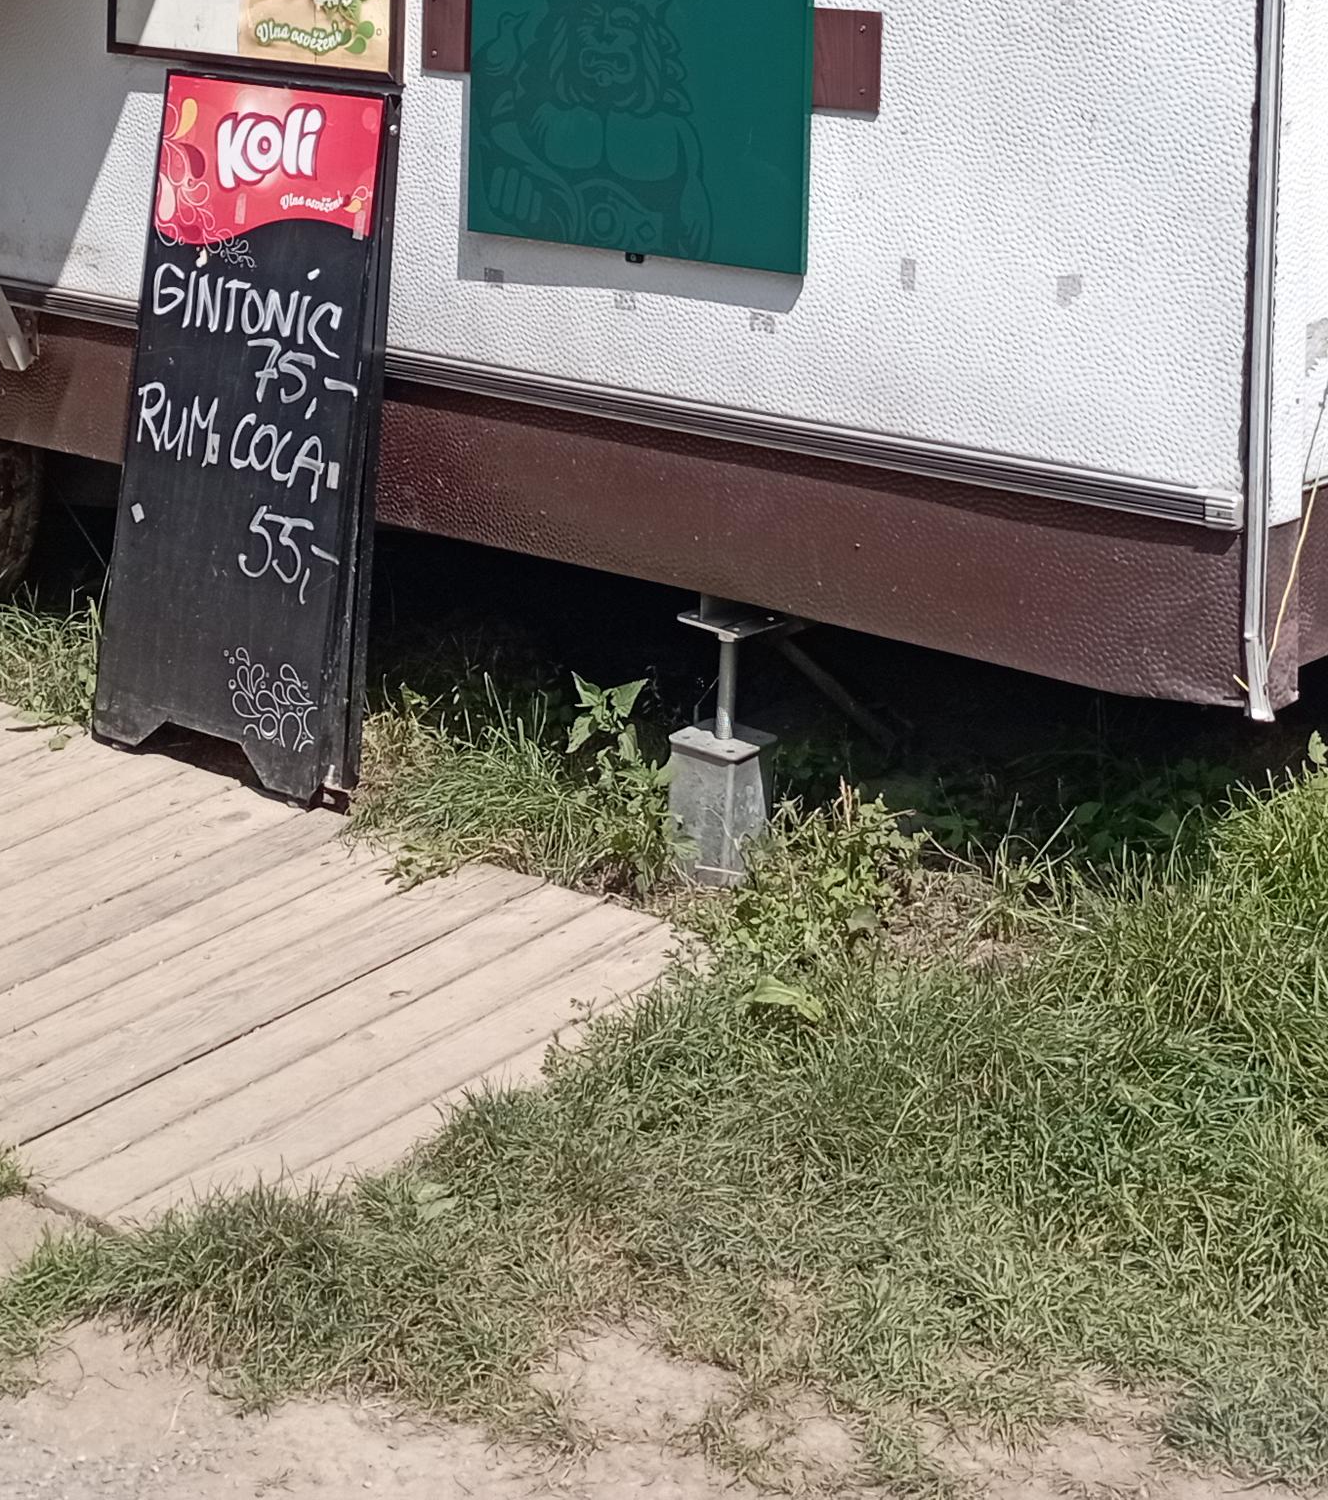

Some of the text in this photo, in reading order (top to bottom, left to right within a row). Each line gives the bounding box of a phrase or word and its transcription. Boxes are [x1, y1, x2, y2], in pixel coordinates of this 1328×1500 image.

[216, 105, 324, 190] Koli
[137, 381, 324, 504] RUM COCA
